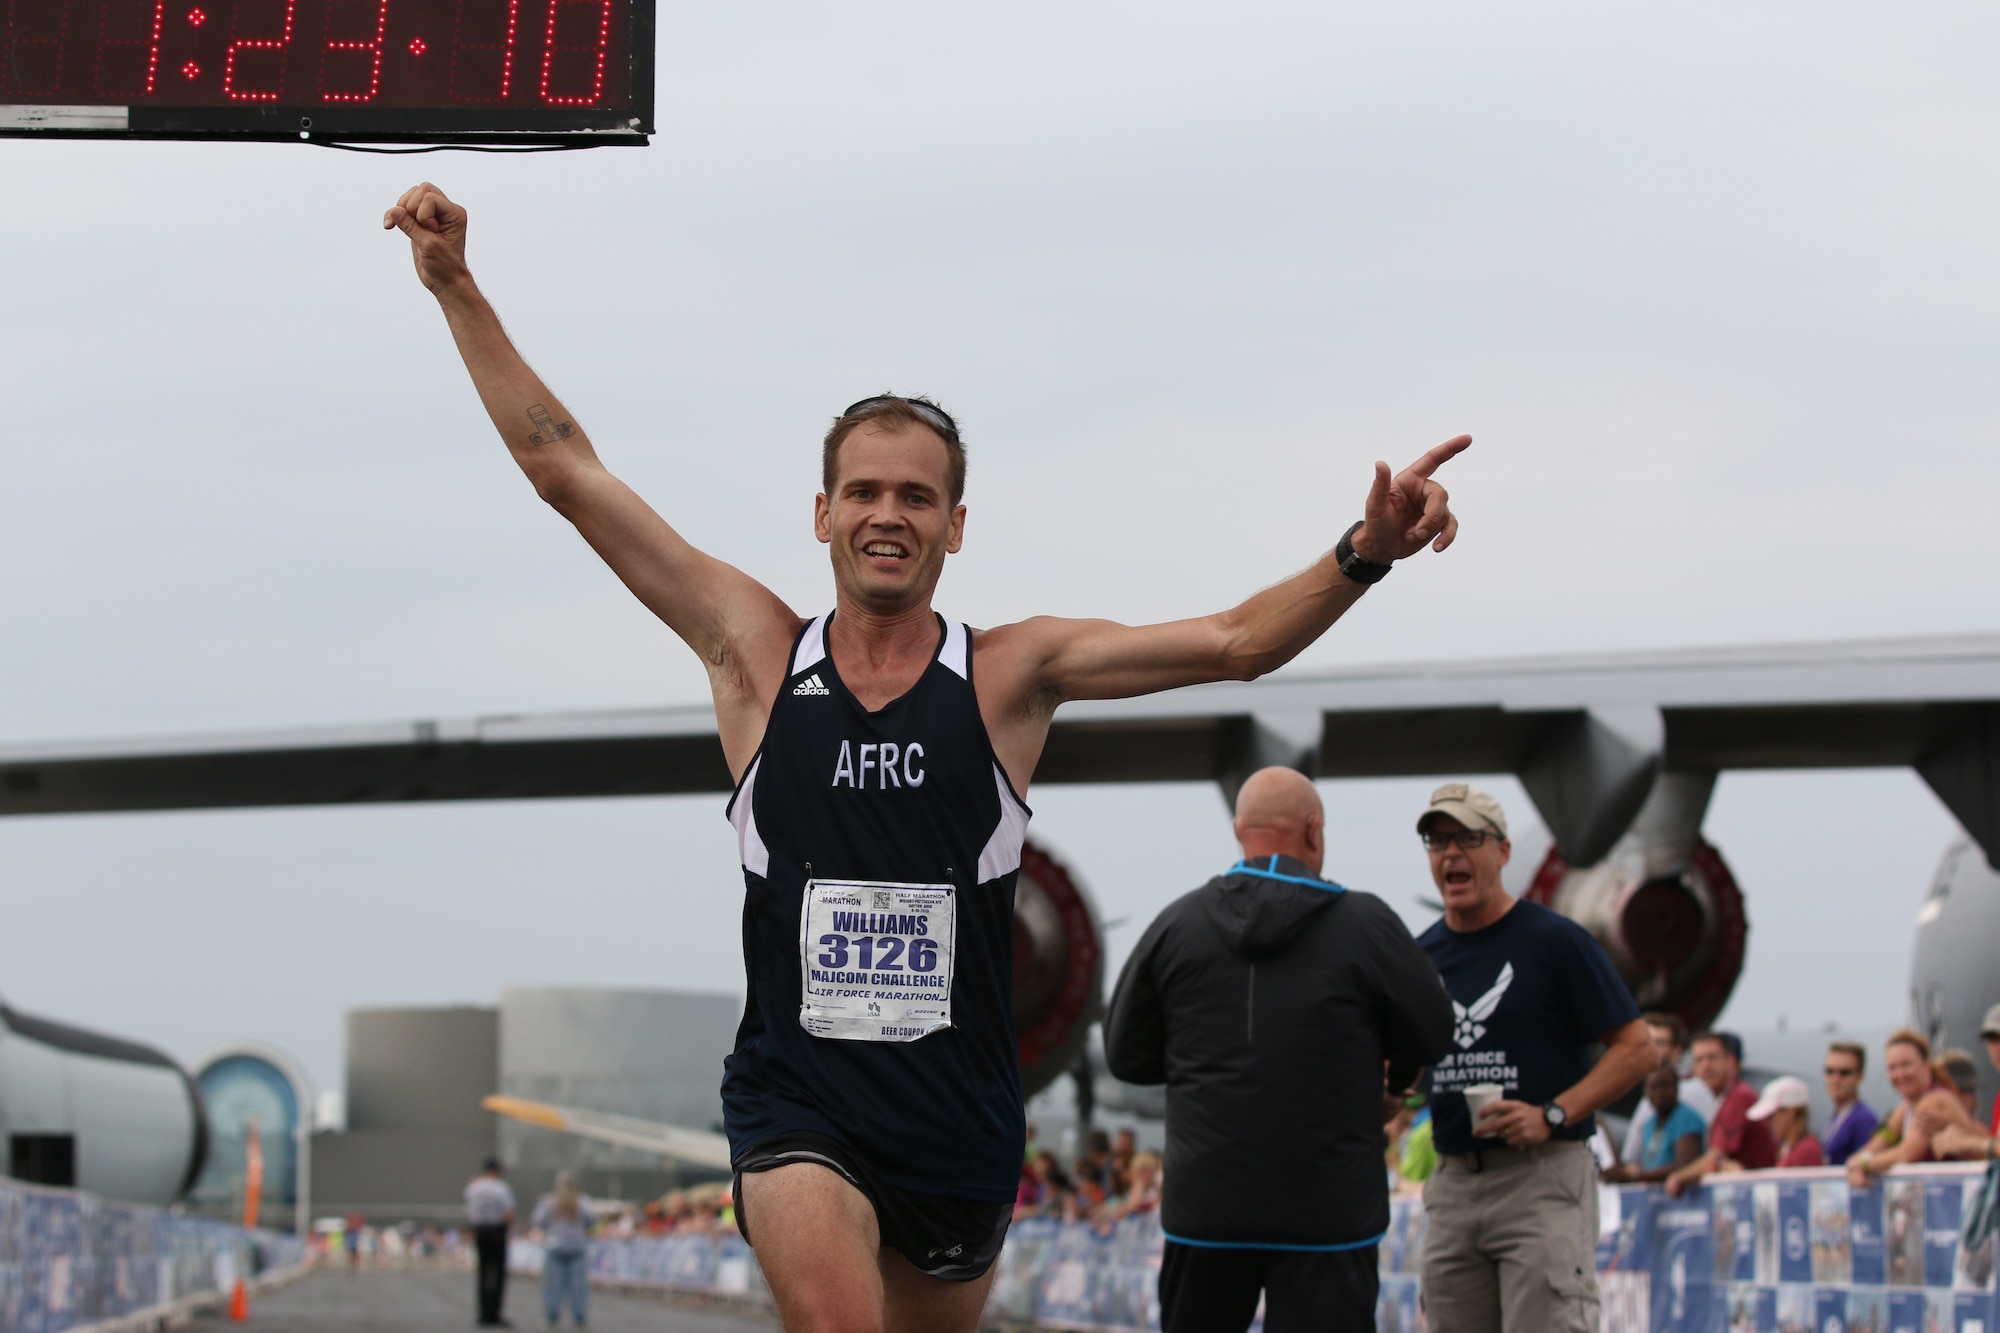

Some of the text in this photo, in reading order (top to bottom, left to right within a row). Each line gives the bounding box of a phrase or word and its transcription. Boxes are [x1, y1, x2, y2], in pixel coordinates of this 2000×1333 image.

[792, 686, 830, 696] adidas
[832, 740, 925, 790] AFRC
[822, 896, 862, 906] MARATHON
[833, 911, 928, 935] WILLIAMS
[818, 934, 938, 972] 3126
[811, 970, 945, 987] MAJCOM CHALLENGE
[814, 988, 940, 1001] AIR FORCE MARATHON
[881, 1026, 924, 1036] BEER COUPON
[1458, 1051, 1506, 1066] FORCE
